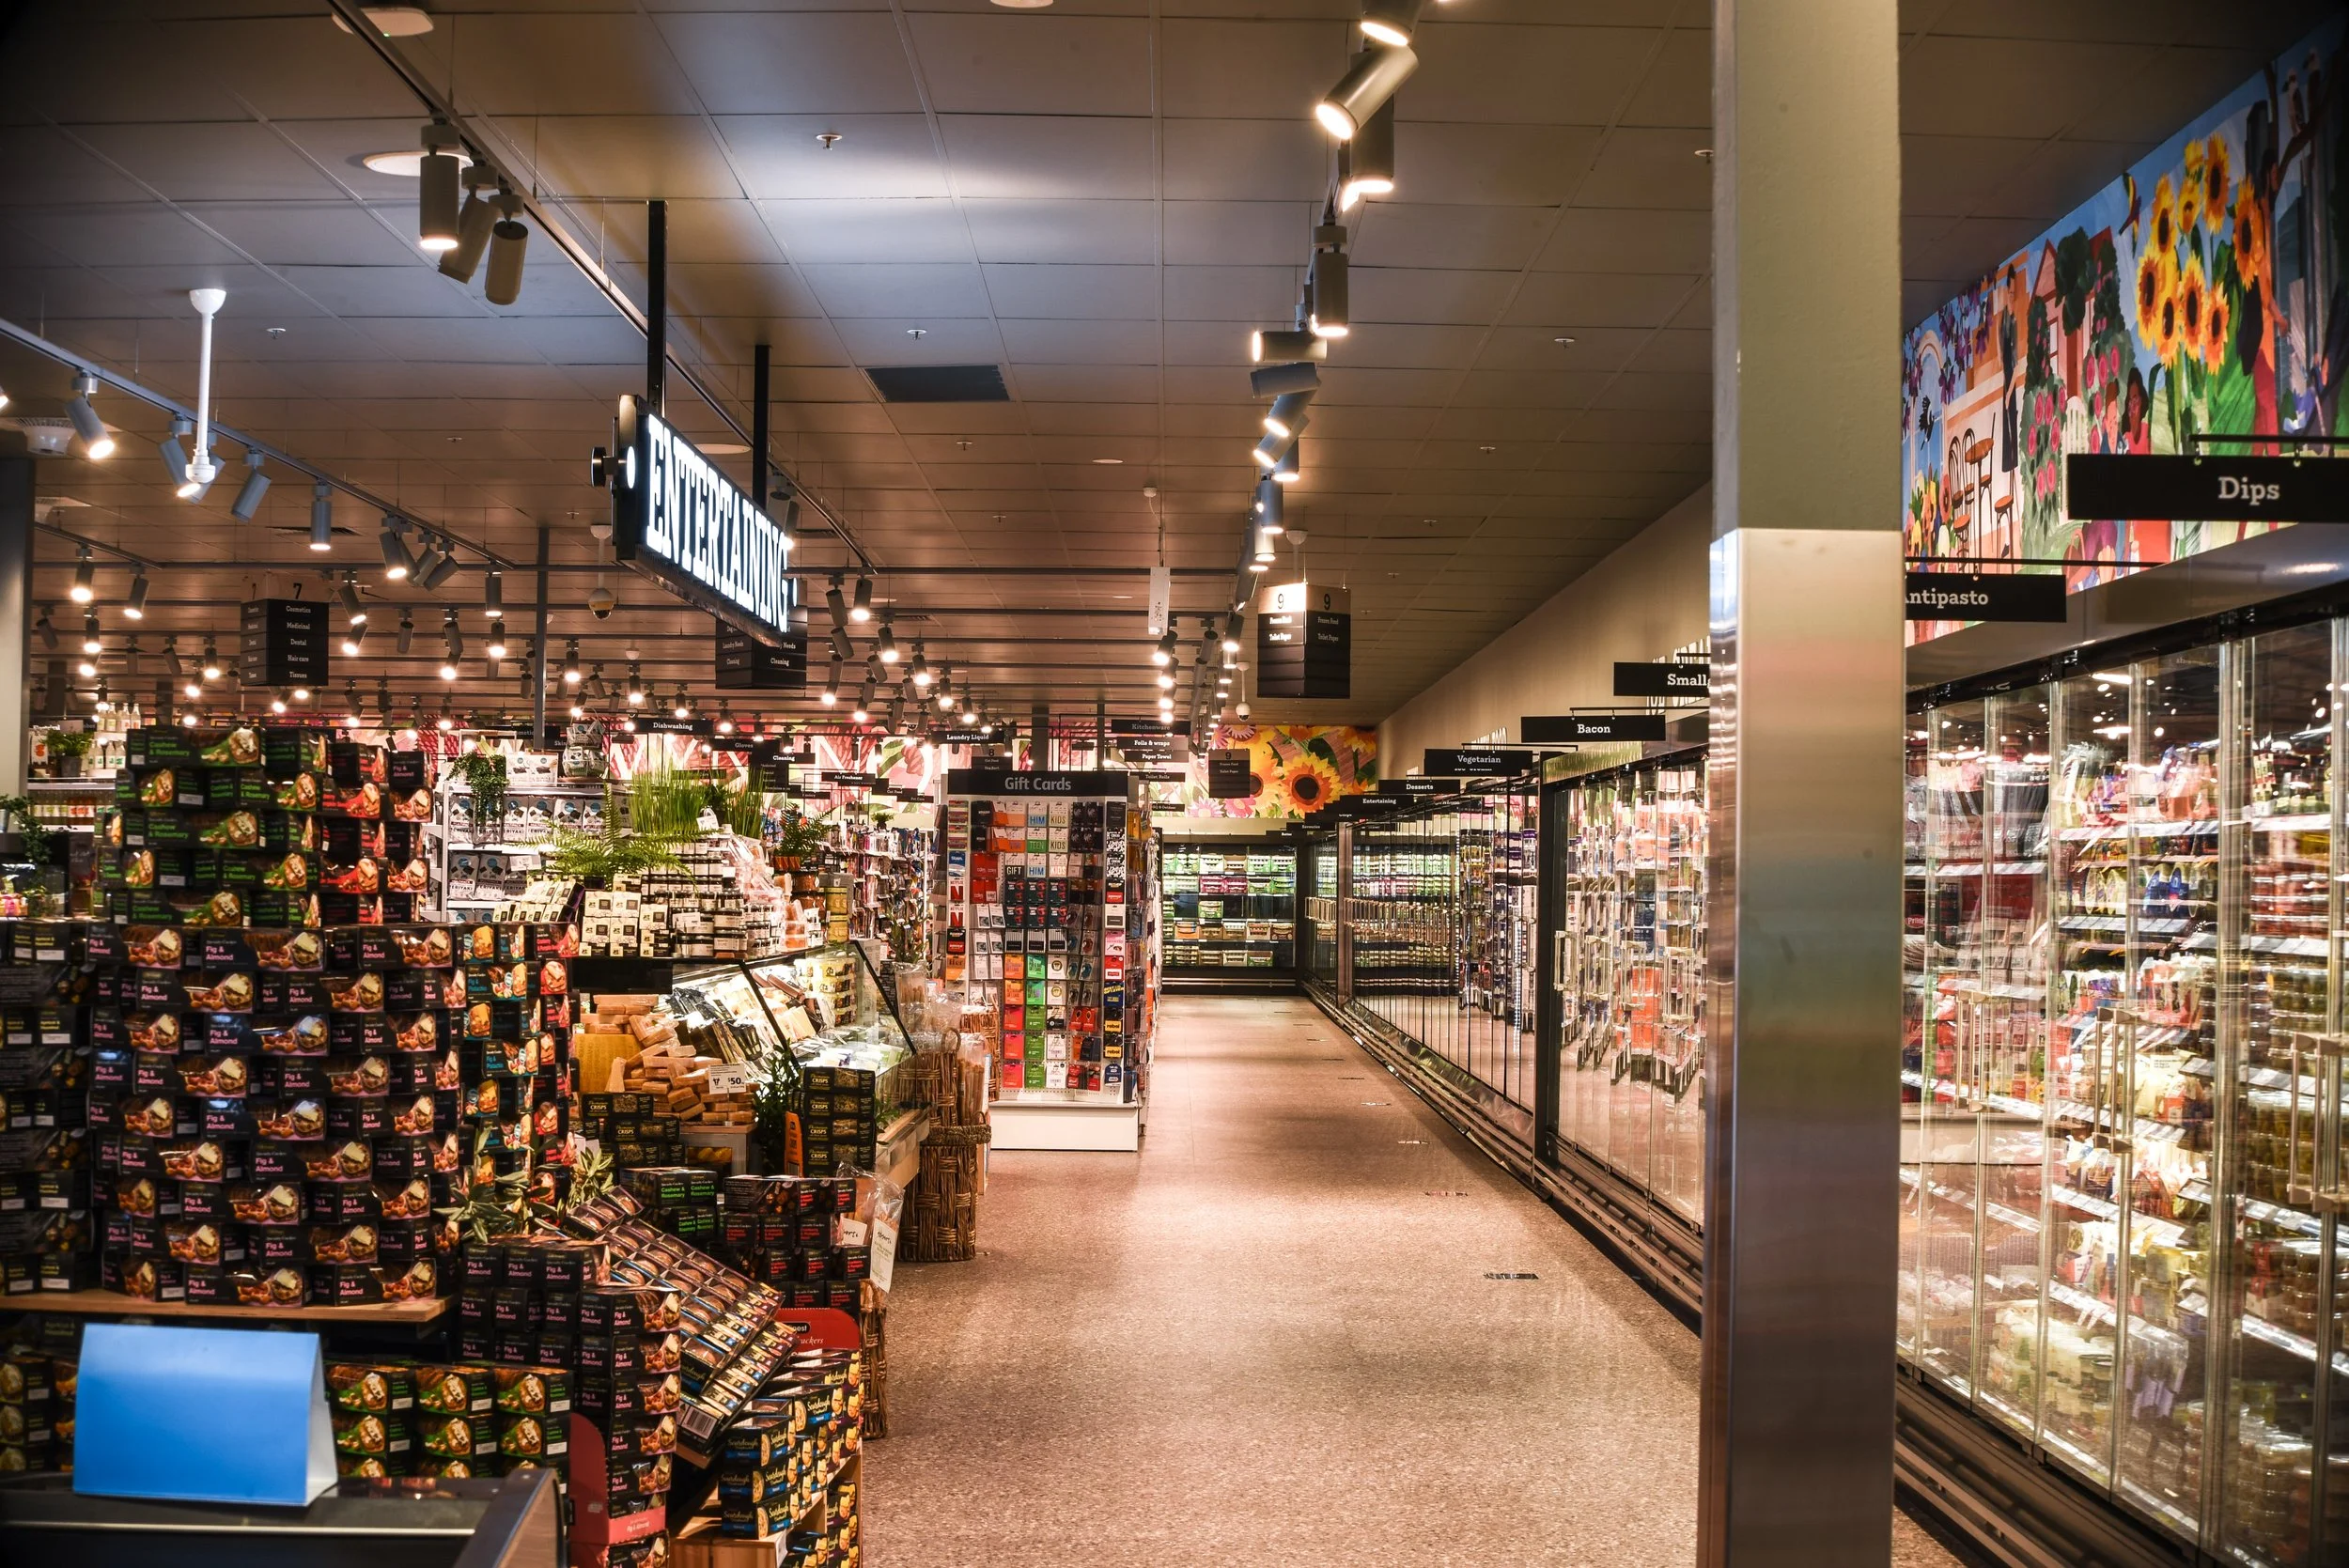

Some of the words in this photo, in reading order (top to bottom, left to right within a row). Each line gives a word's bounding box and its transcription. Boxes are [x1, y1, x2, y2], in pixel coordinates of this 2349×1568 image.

[2218, 476, 2280, 505] Dips
[646, 413, 788, 633] ENTERTAINING
[293, 583, 303, 599] 7
[1278, 594, 1284, 609] 9
[1324, 594, 1330, 610] 9
[286, 605, 311, 613] Cosmetics
[770, 658, 789, 666] Cleaning
[653, 722, 693, 730] Dishwashing
[1577, 723, 1610, 734] Bacon
[1457, 755, 1501, 764] Vegetarian
[1004, 777, 1030, 791] Gift
[1033, 777, 1071, 791] Cards
[1050, 815, 1066, 824] KIDS
[1030, 841, 1045, 849] TEEN
[1050, 841, 1066, 850] KIDS
[1006, 866, 1021, 875] GIFT
[1050, 866, 1066, 875] KIDS
[807, 1399, 831, 1411] Sourdough
[766, 1467, 786, 1481] Sourdough
[769, 1503, 789, 1517] Sourdough
